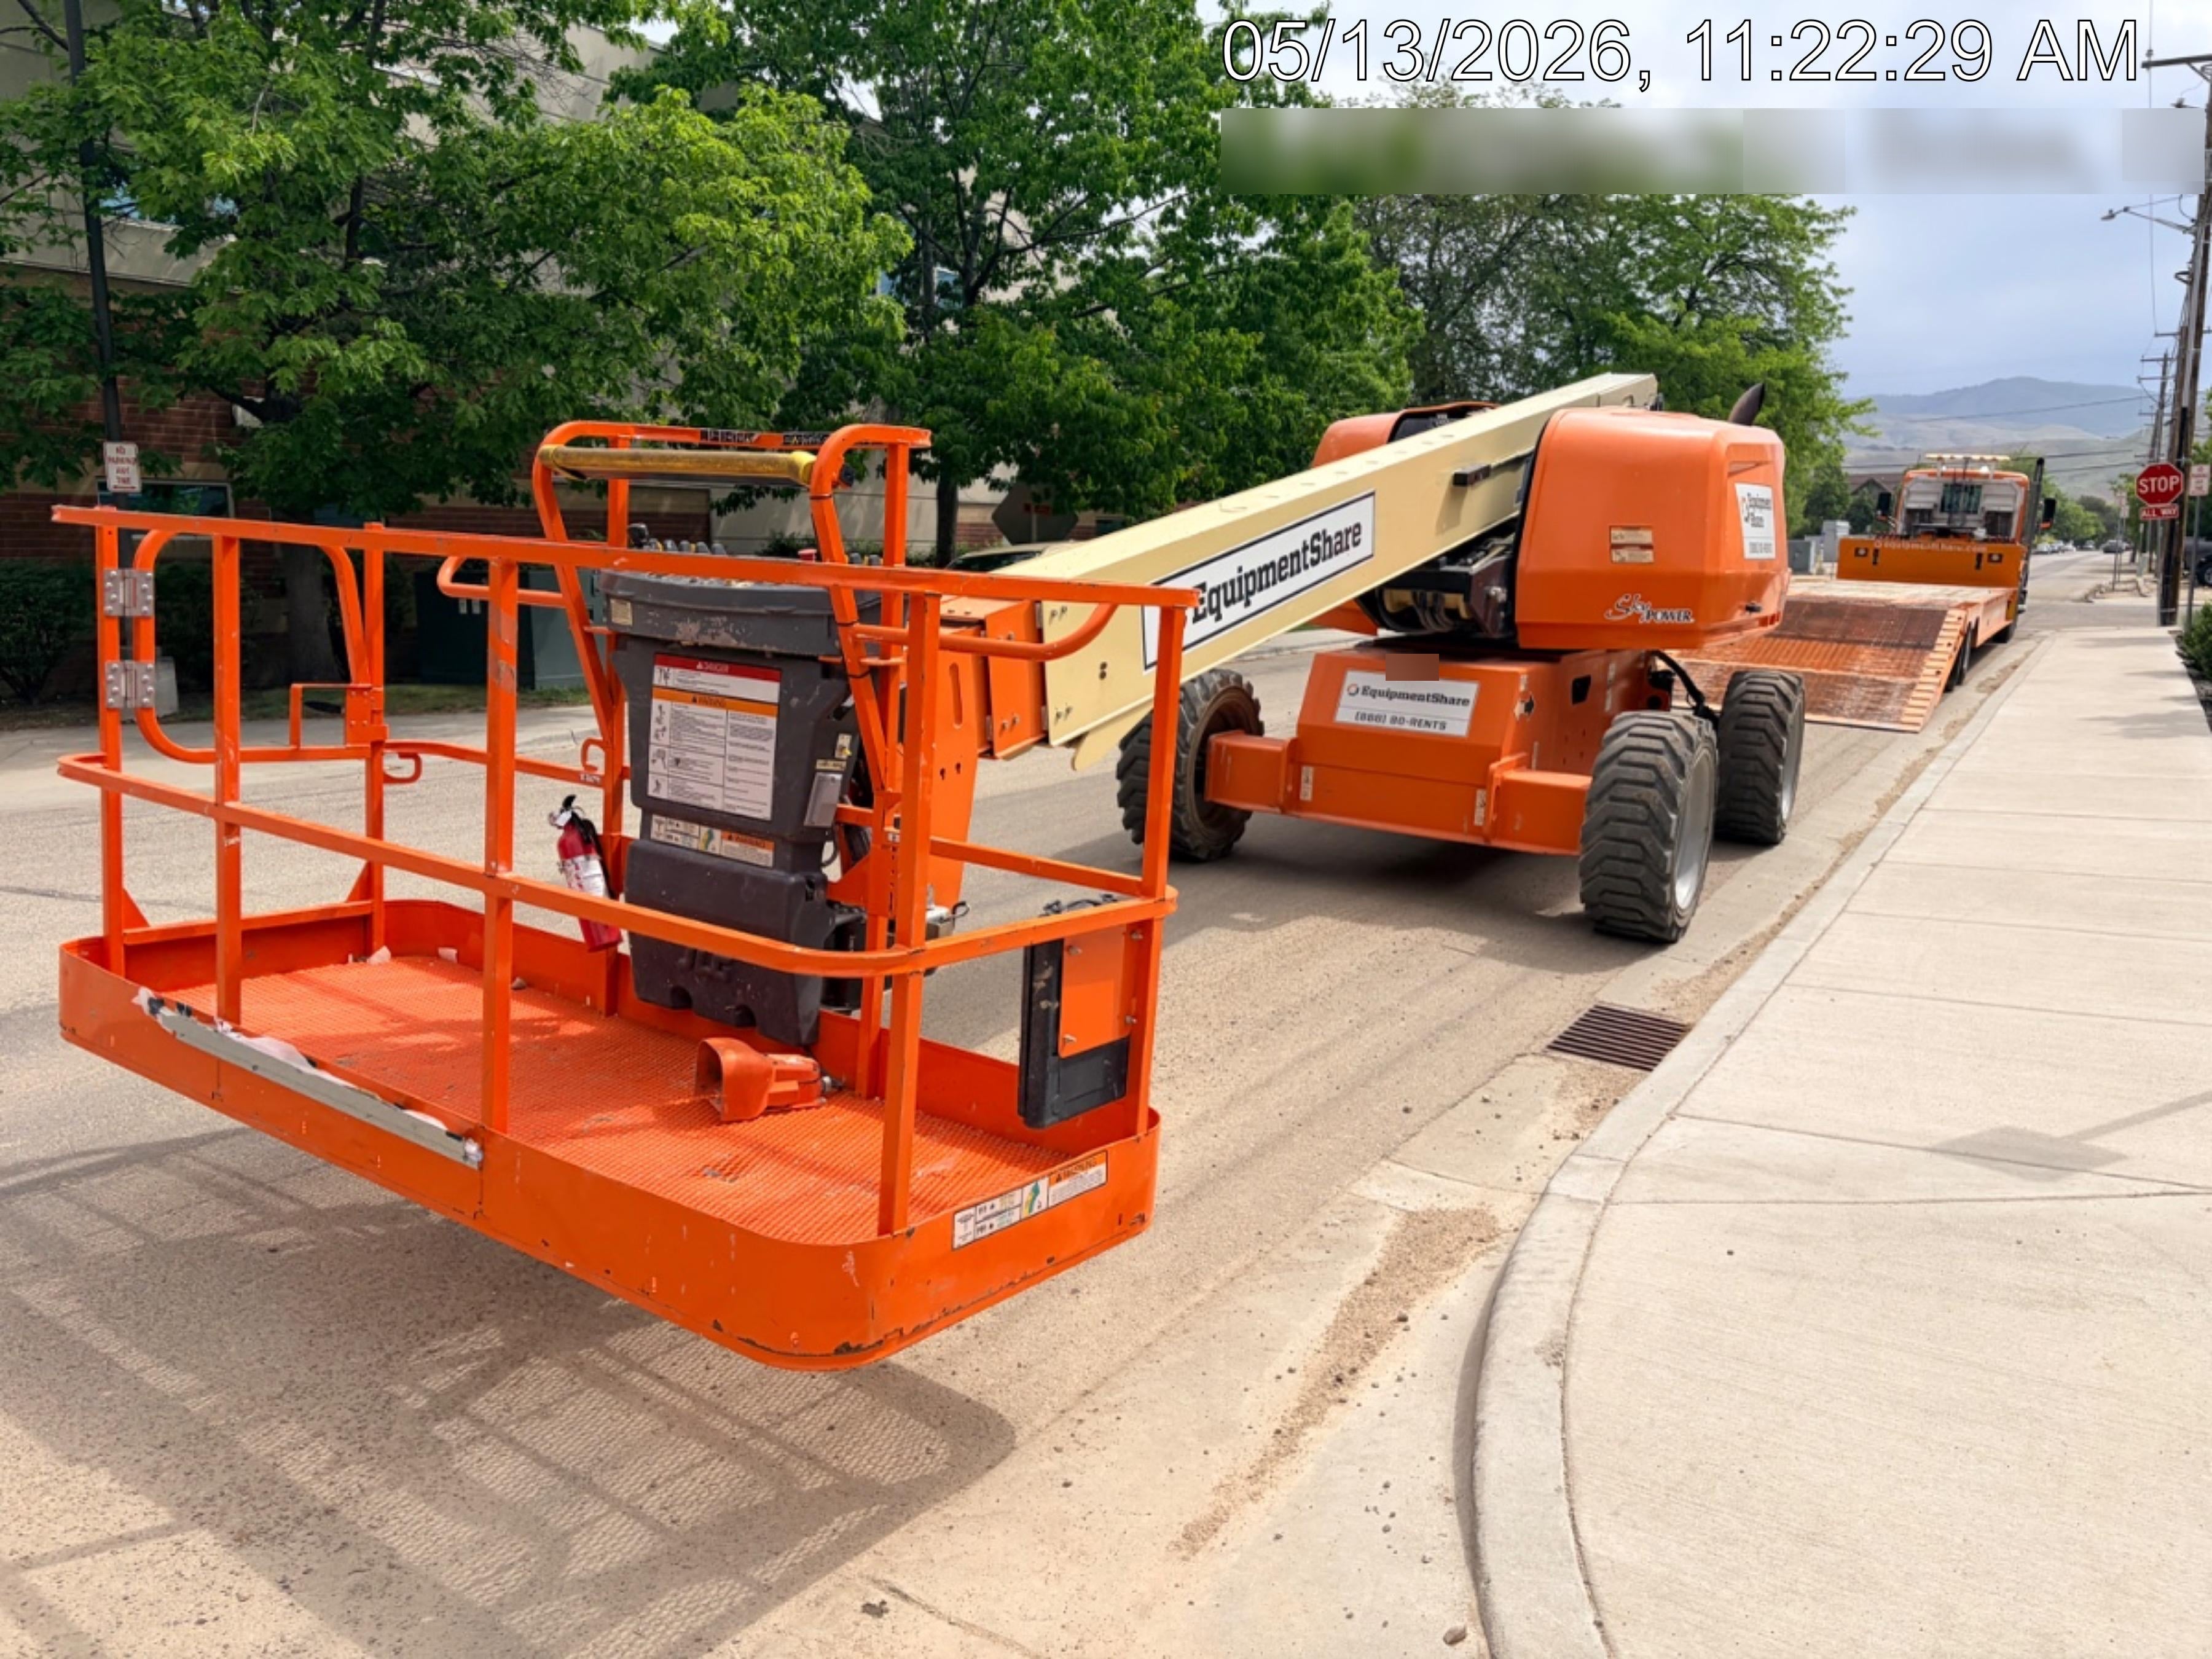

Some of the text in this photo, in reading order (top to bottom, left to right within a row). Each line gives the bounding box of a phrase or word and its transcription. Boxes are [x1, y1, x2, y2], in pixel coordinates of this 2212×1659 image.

[2139, 474, 2180, 495] STOP
[1192, 522, 1361, 624] EquipmentShare
[1362, 685, 1470, 707] EquipmentShare
